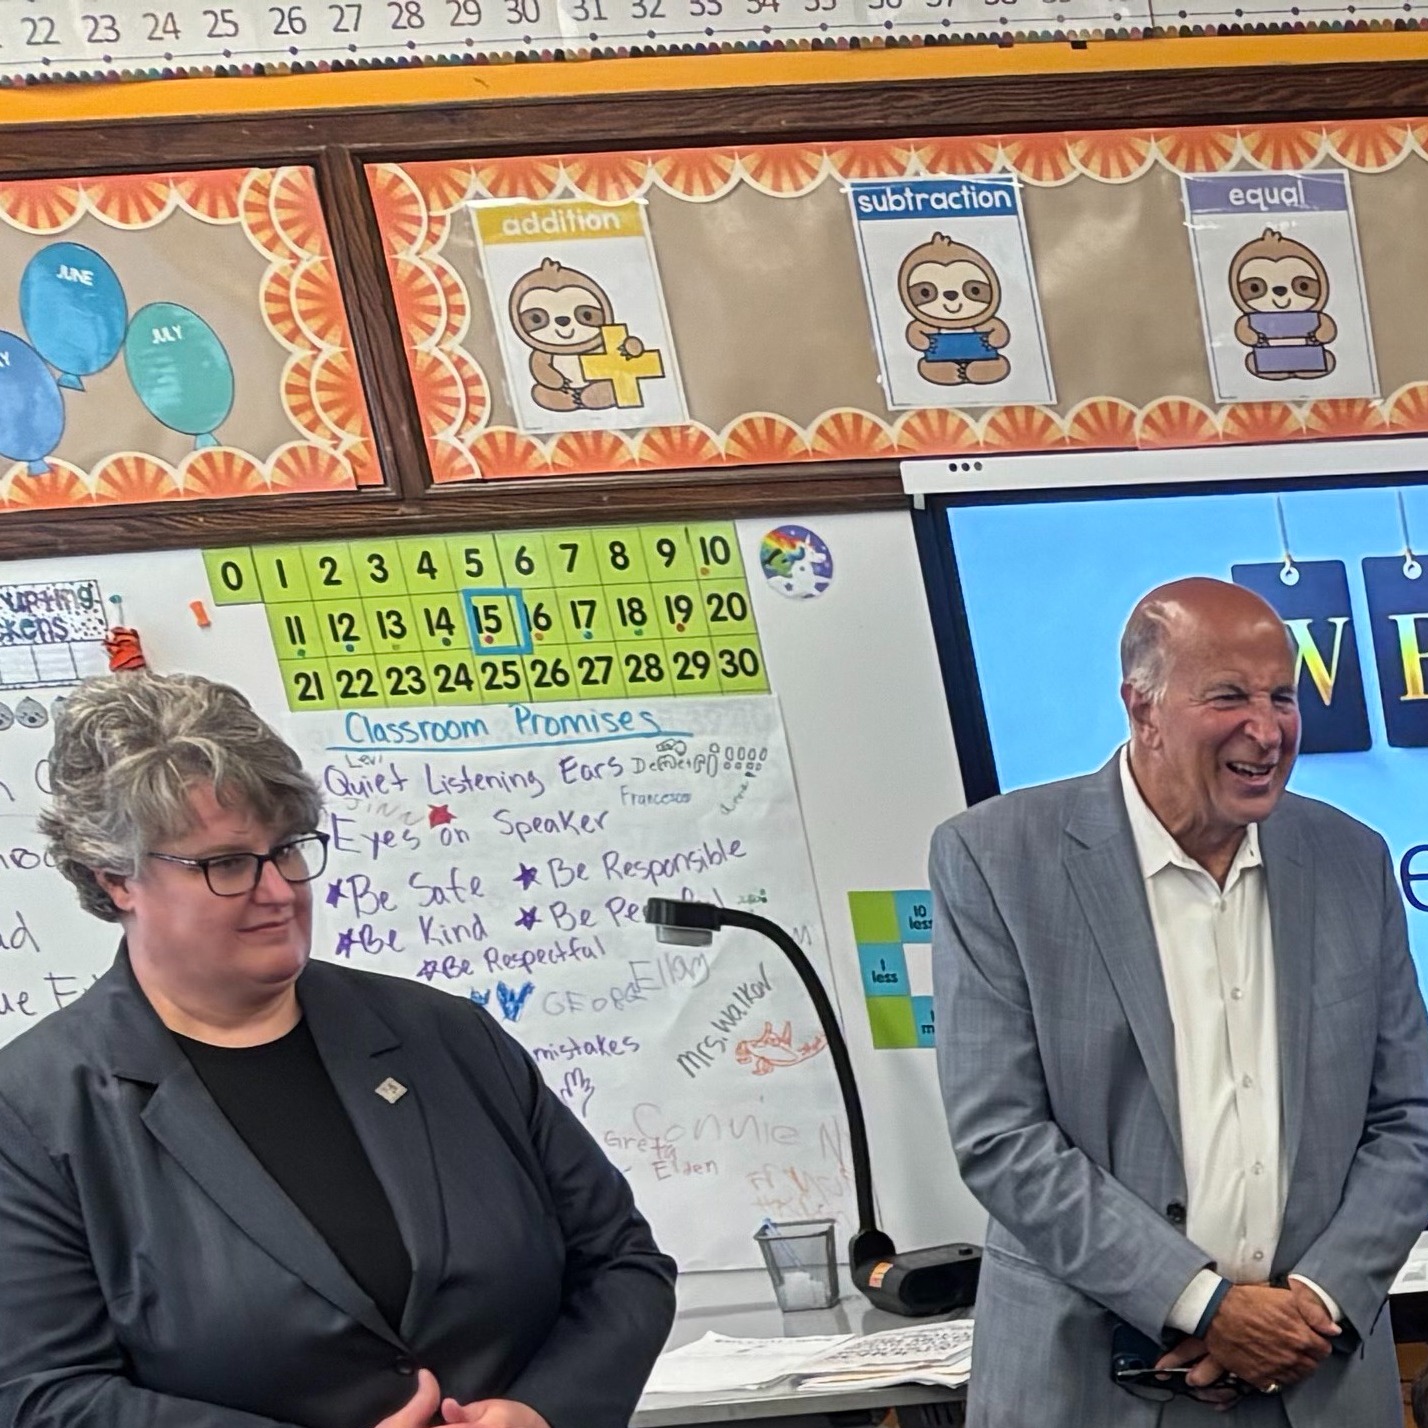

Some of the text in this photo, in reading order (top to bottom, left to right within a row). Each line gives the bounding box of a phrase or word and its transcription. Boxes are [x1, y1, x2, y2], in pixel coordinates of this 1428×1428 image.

[21, 17, 60, 45] 22
[81, 15, 120, 43] 23
[143, 12, 181, 41] 24
[203, 9, 239, 38] 25
[269, 6, 307, 35] 26
[328, 4, 362, 33] 27
[387, 1, 425, 30] 28
[450, 0, 482, 27] 29
[506, 0, 541, 24] 30
[859, 185, 1012, 215] subtraction
[1229, 180, 1305, 211] equal
[502, 210, 620, 237] addition
[56, 264, 94, 286] JUNE
[152, 325, 182, 345] JULY
[221, 535, 731, 591] 0 1 2 3 4 5 6 7 8 9 10
[286, 592, 747, 645] 11 12 13 14 15 16 17 18 19 20
[294, 648, 759, 701] 21 22 23 24 25 26 27 28 29 30
[345, 703, 661, 743] Classroom Promises
[324, 755, 624, 798] Quiet Listening Ears
[331, 808, 610, 860] Eyes on Speaker
[547, 838, 747, 889] Be Responsible
[346, 867, 485, 919] Be Safe
[913, 905, 927, 918] 10
[359, 913, 489, 955] Be Kind
[549, 901, 597, 932] Be
[442, 936, 607, 980] Be Respectful
[871, 970, 899, 984] less
[533, 1034, 640, 1063] mistakes
